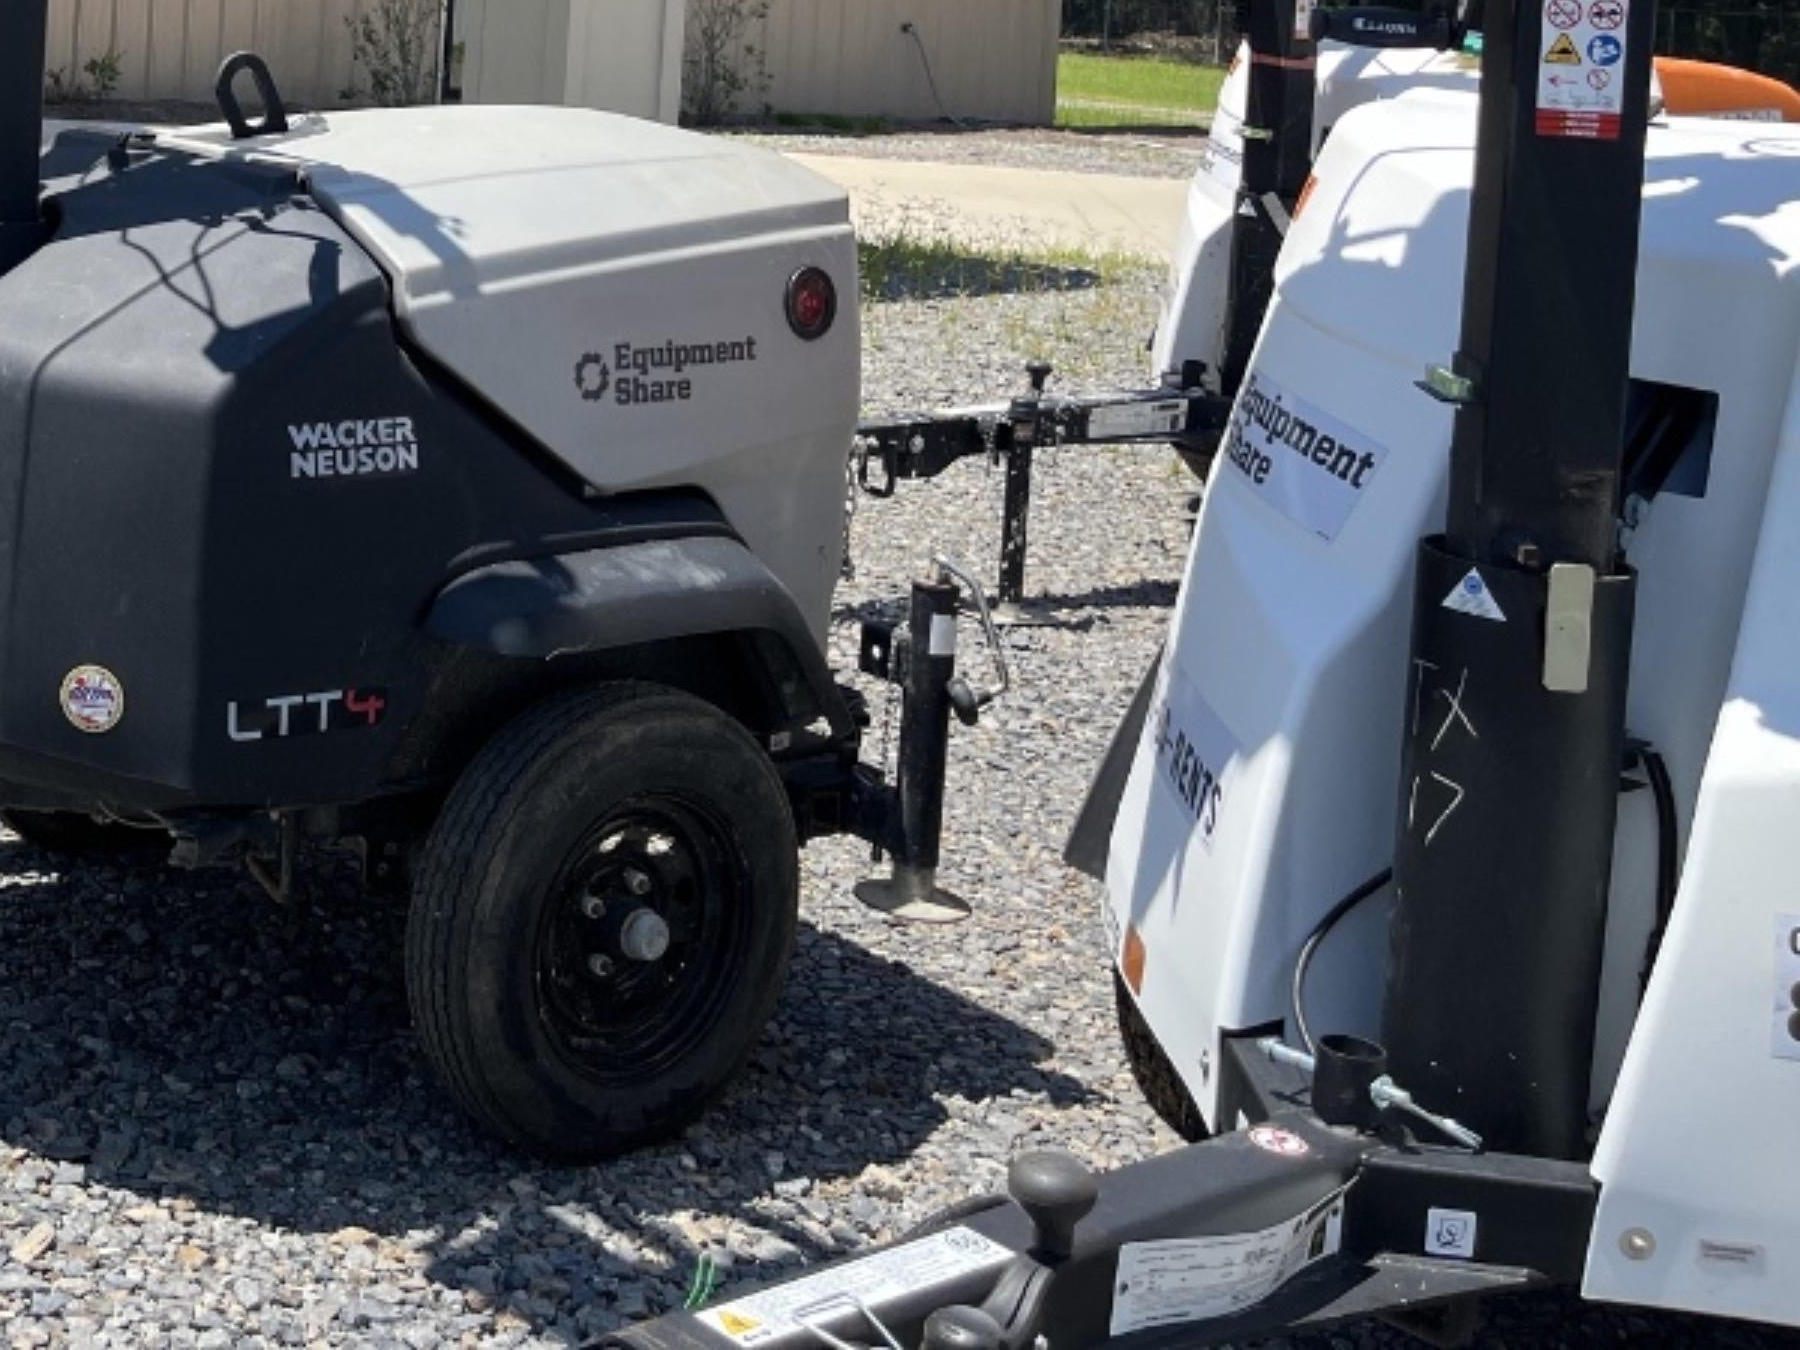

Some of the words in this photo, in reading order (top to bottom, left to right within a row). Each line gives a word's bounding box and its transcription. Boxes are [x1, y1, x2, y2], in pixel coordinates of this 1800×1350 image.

[615, 335, 757, 376] Equipment
[615, 377, 692, 406] Share
[287, 416, 417, 450] WACKER
[290, 443, 419, 478] NEUSON
[227, 688, 385, 741] LTT4
